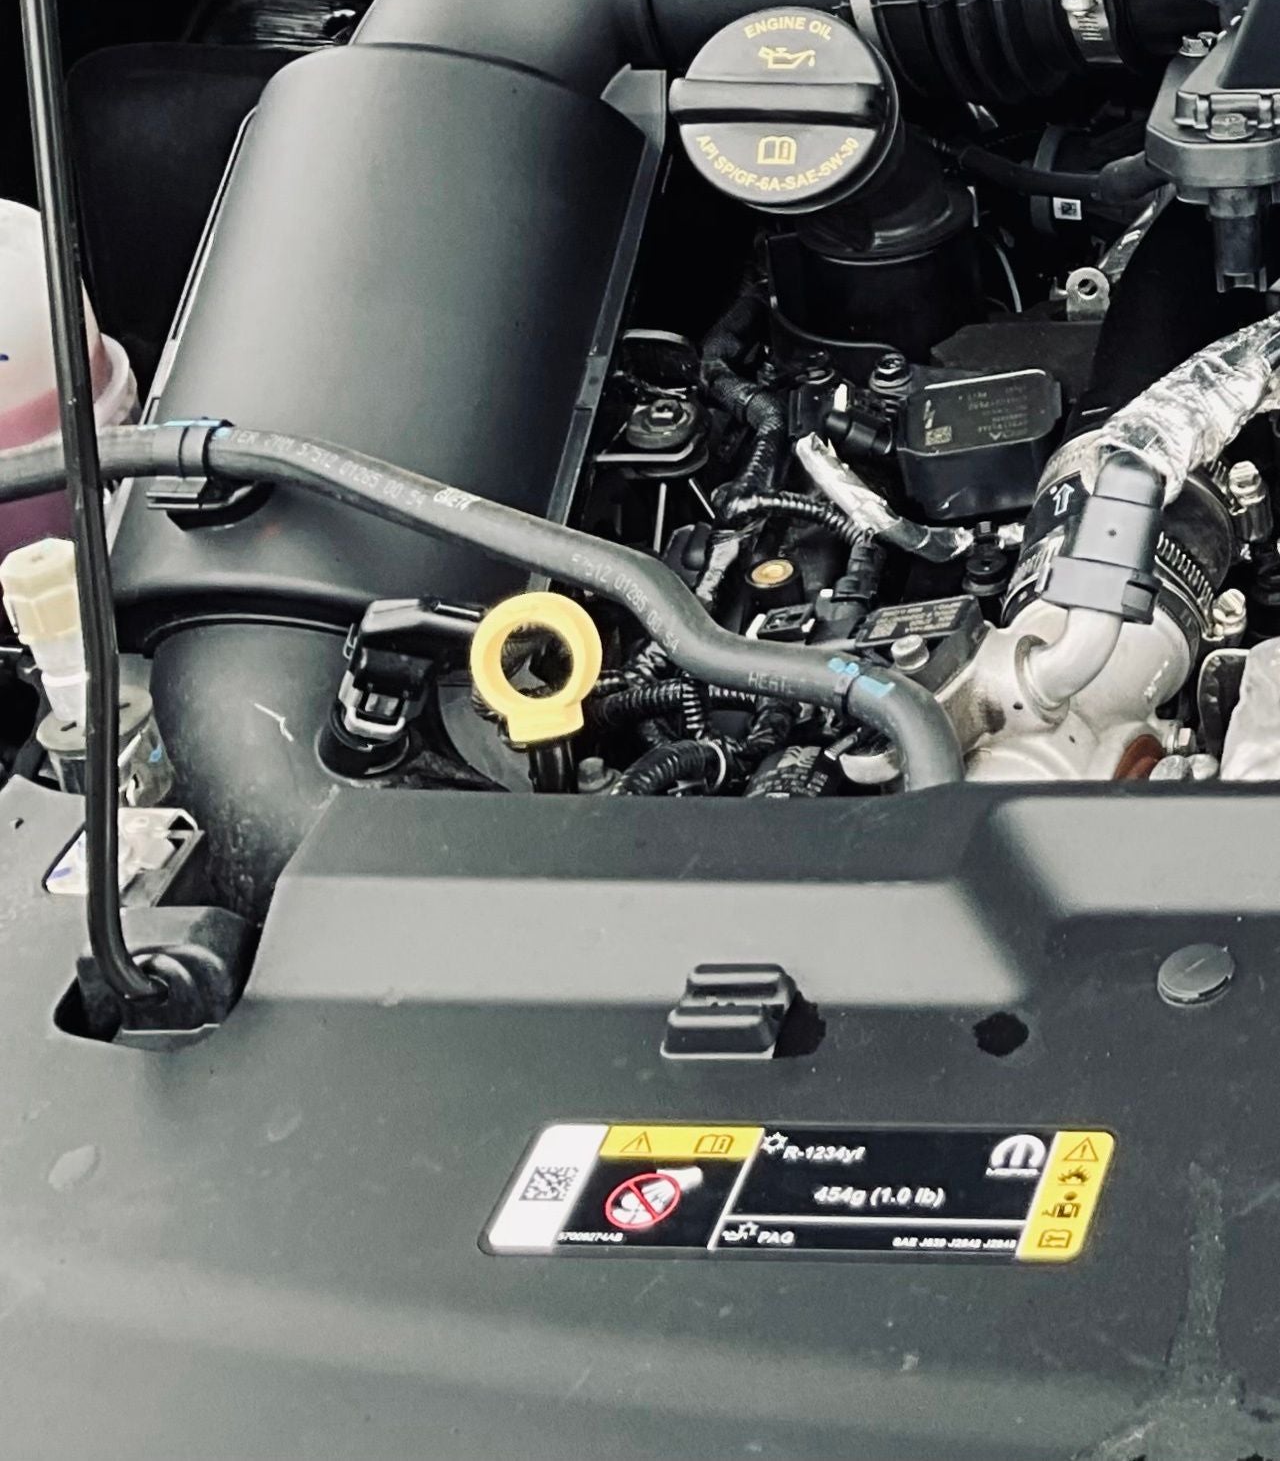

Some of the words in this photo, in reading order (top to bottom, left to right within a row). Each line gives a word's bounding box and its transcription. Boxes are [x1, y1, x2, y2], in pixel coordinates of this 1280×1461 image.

[743, 16, 806, 40] ENGINE
[808, 19, 833, 41] OIL
[696, 134, 720, 160] API
[782, 1144, 866, 1164] R-1234yf
[813, 1186, 868, 1208] 454g
[869, 1186, 911, 1208] (1.0
[913, 1186, 947, 1209] lb)
[756, 1230, 796, 1246] PAG
